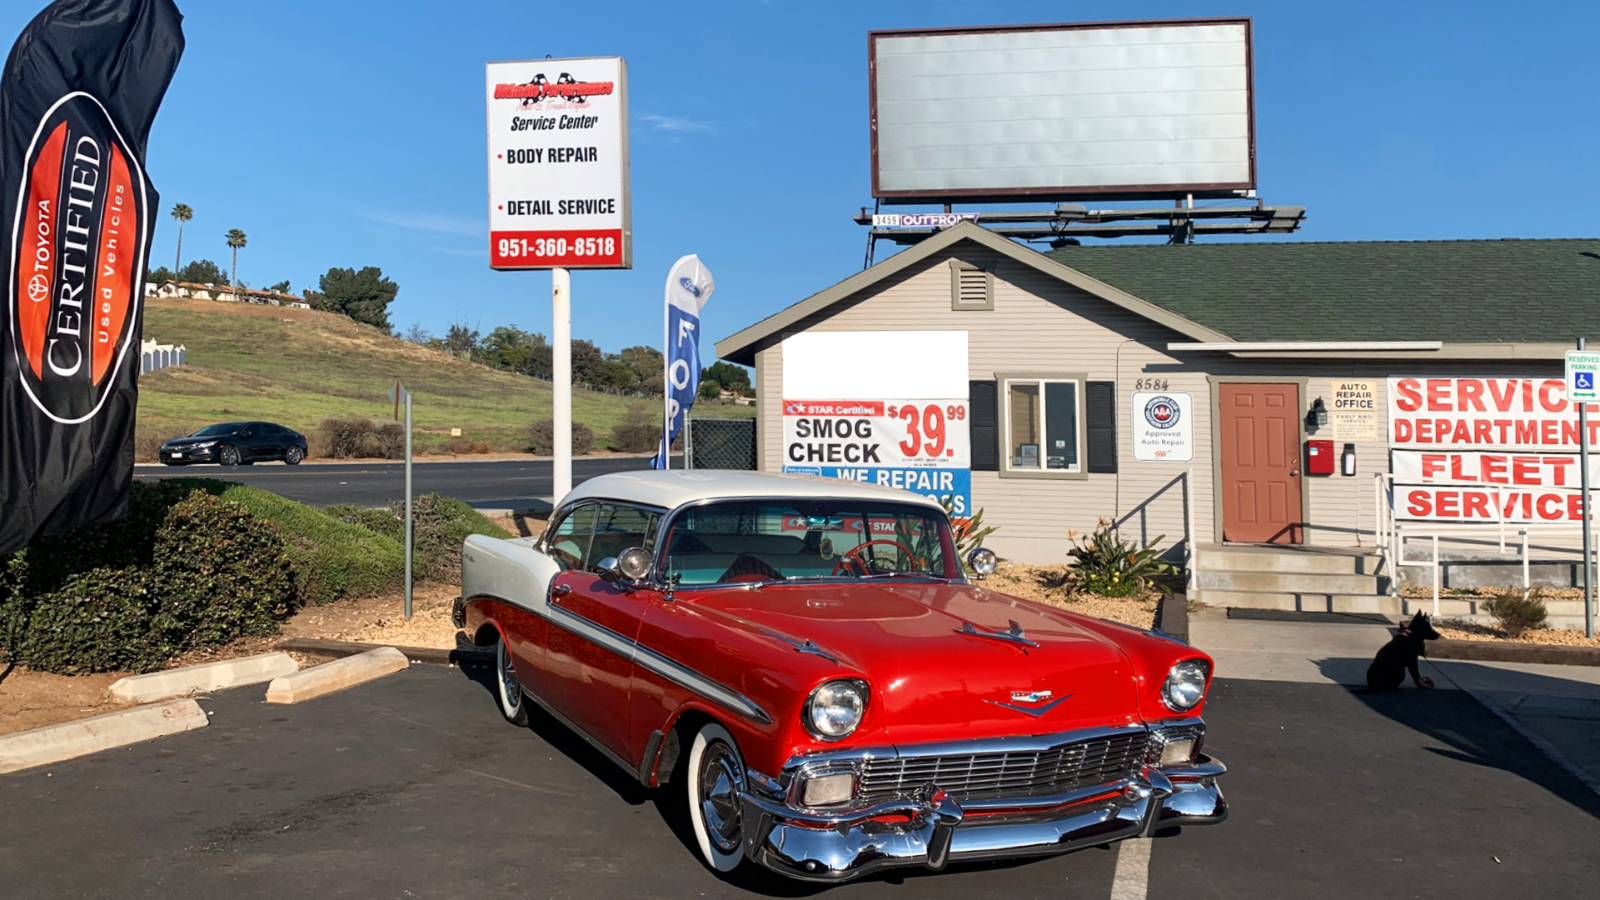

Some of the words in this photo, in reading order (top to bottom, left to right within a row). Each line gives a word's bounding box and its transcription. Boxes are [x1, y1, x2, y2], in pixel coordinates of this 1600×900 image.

[510, 115, 556, 132] Service
[558, 114, 599, 130] Center
[507, 148, 544, 164] BODY
[548, 146, 598, 163] REPAIR
[507, 200, 554, 216] DETAIL
[558, 198, 615, 215] SERVICE
[103, 184, 124, 277] Vehicles
[876, 215, 897, 225] 3459
[34, 199, 50, 272] TOYOTA
[47, 135, 101, 377] CERTIFIED
[498, 236, 615, 258] 951-360-8518
[98, 287, 112, 344] Used
[1135, 378, 1169, 391] 8584
[1340, 383, 1368, 391] AUTO
[808, 405, 834, 415] STAR
[835, 405, 875, 415] Certified
[1154, 407, 1171, 417] AAA
[1335, 399, 1374, 408] OFFICE
[795, 418, 873, 439] SMOG
[1394, 418, 1600, 445] DEPARTMENT
[788, 442, 881, 463] CHECK
[877, 469, 954, 491] REPAIR
[1421, 454, 1575, 486] FLEET
[1407, 490, 1593, 521] SERVICE
